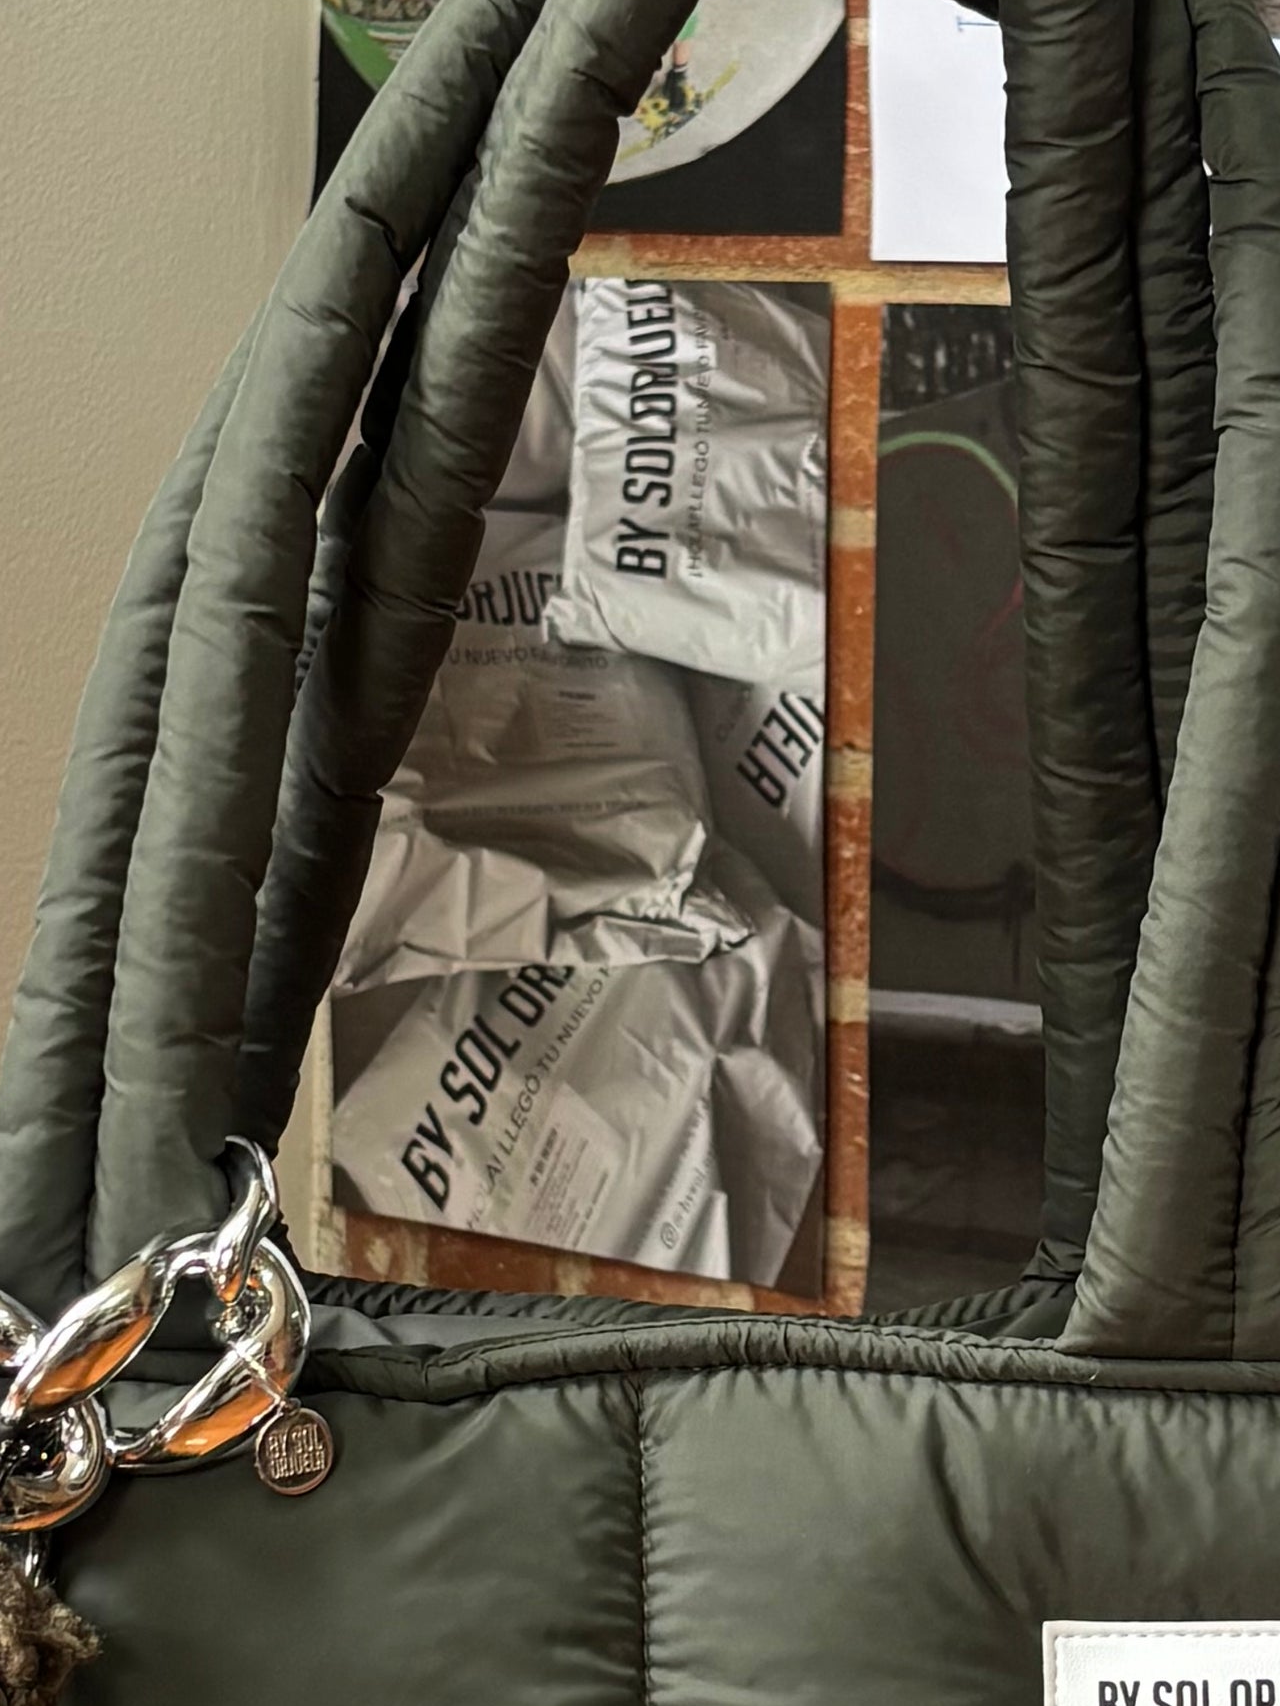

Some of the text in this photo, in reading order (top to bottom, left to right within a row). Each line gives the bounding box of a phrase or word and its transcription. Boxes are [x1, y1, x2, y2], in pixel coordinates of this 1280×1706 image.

[615, 516, 671, 580] BY
[539, 1044, 561, 1074] TU
[558, 978, 604, 1047] NUEVO
[401, 1102, 455, 1213] BY
[440, 1013, 522, 1127] SOL
